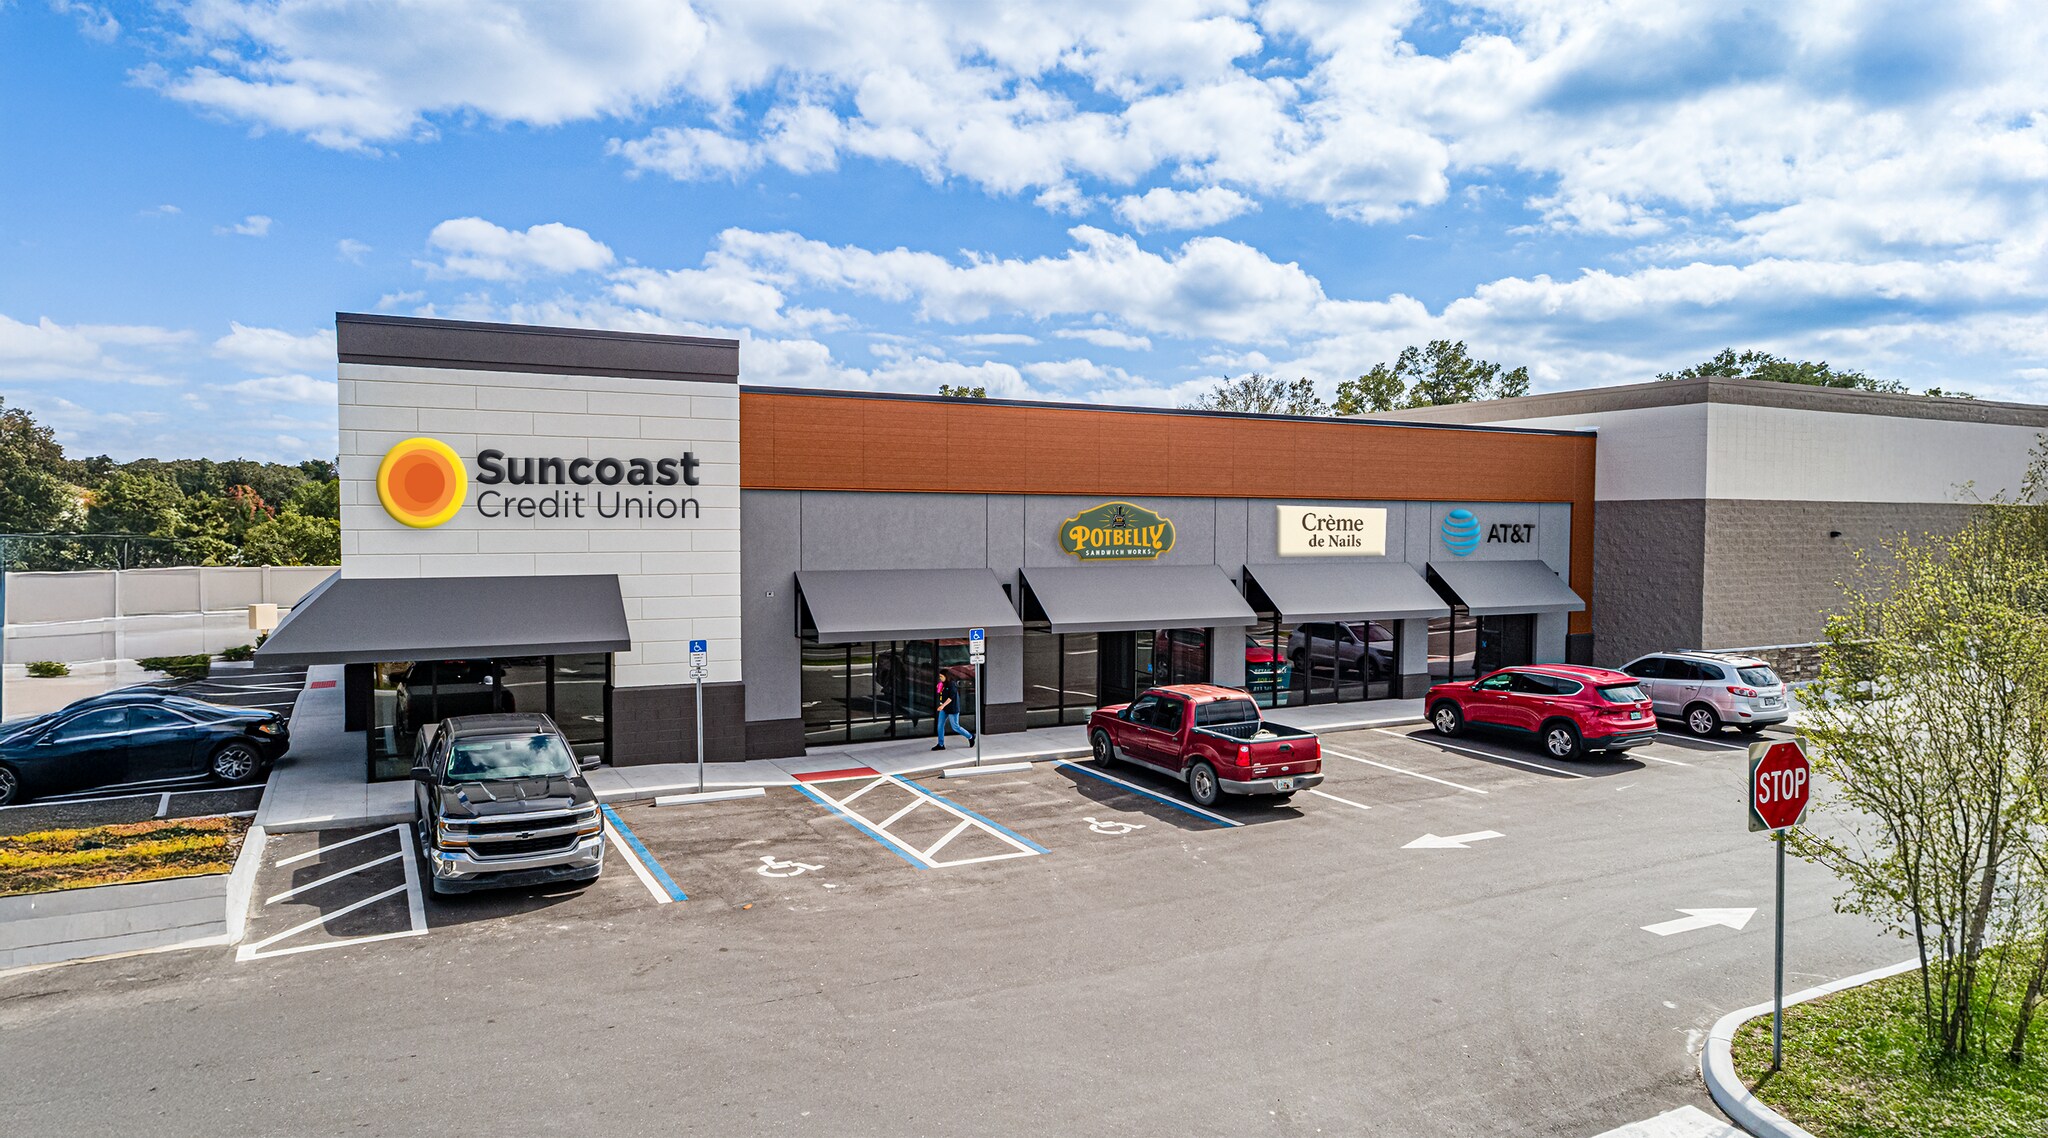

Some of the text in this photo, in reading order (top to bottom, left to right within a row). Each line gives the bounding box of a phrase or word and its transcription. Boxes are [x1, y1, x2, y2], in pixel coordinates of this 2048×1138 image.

[476, 449, 700, 486] Suncoast
[476, 490, 700, 519] Credit Union
[1301, 512, 1364, 532] Crème
[1487, 524, 1536, 544] AT&T
[1069, 523, 1166, 551] POTBELLY
[1308, 533, 1362, 547] de Nails
[1758, 767, 1807, 804] STOP
